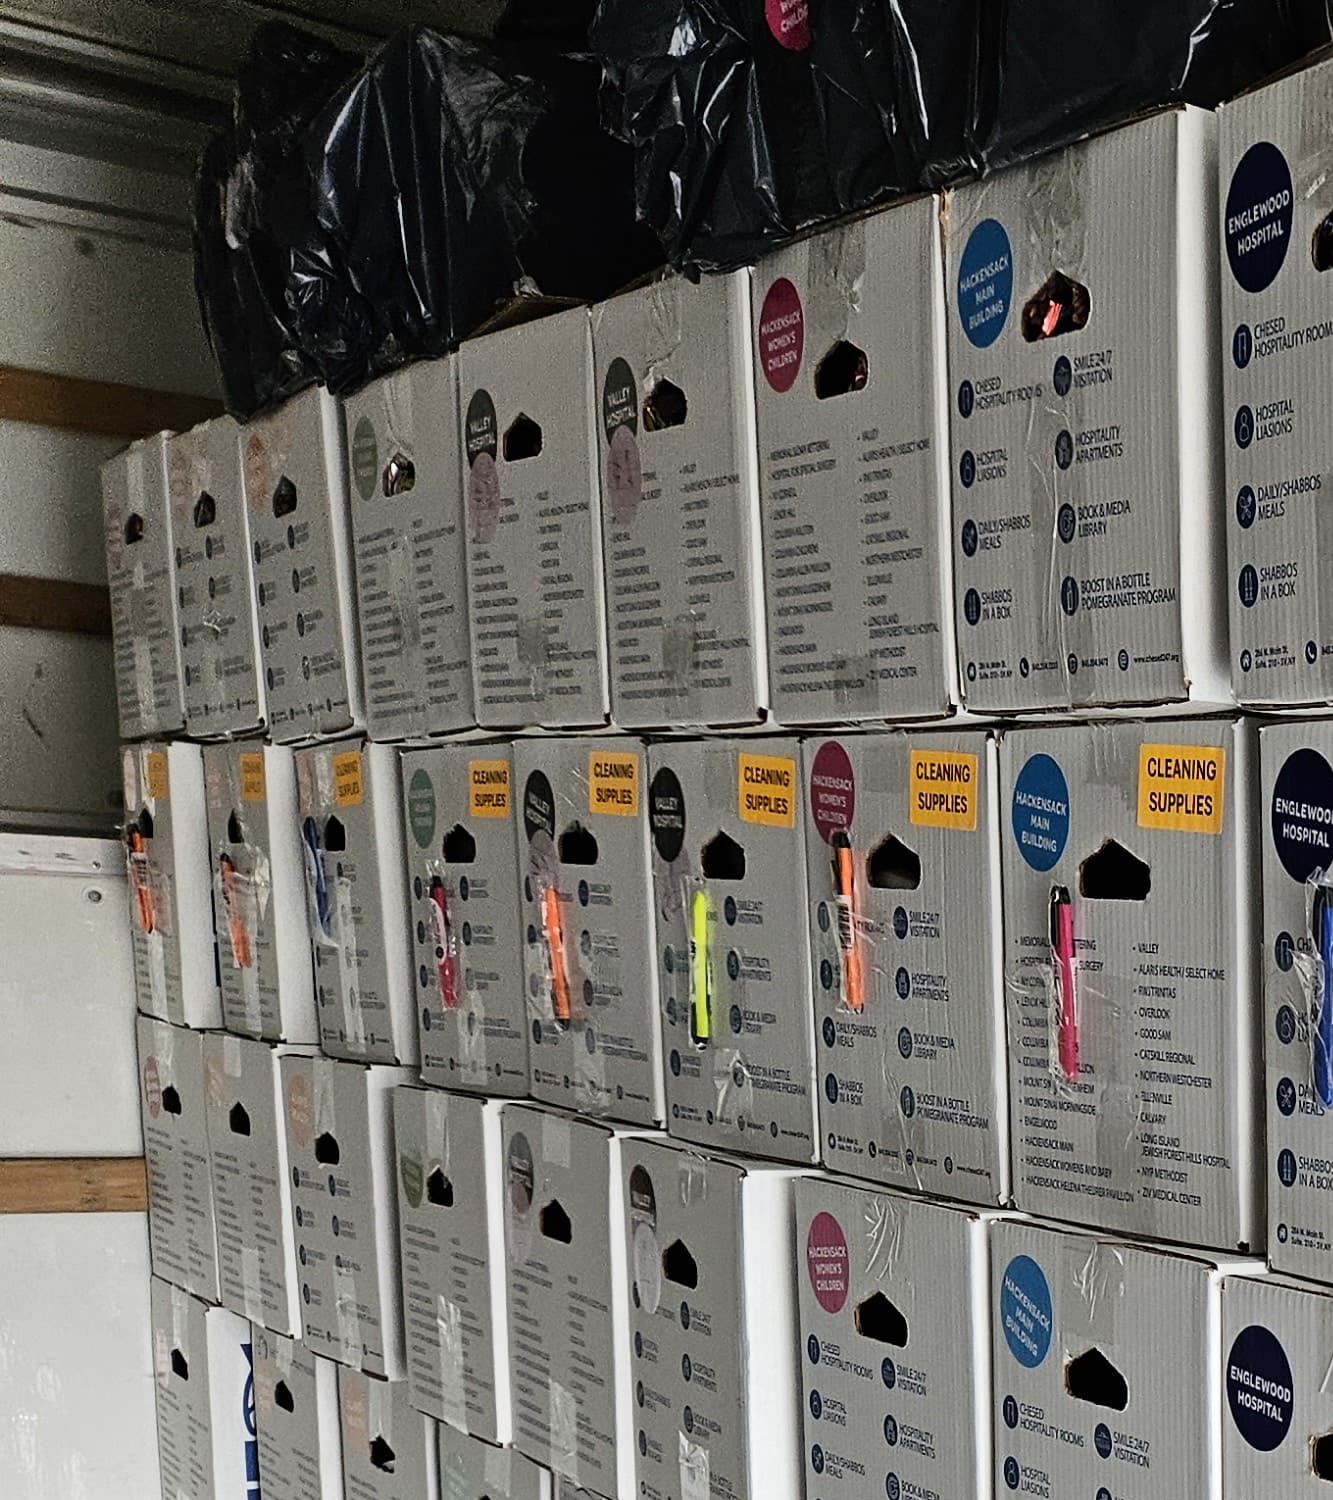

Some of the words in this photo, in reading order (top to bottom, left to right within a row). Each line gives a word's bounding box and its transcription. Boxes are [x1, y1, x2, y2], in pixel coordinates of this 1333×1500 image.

[1229, 189, 1290, 235] ENGLEWOOD
[1238, 223, 1283, 255] HOSPITAL
[473, 770, 507, 785] CLEANING
[594, 763, 633, 779] CLEANING
[744, 767, 789, 787] CLEANING
[475, 794, 506, 807] SUPPLIES
[596, 788, 632, 804] SUPPLIES
[746, 794, 788, 814] SUPPLIES
[1283, 824, 1329, 847] HOSPITAL
[1230, 1365, 1291, 1402] ENGLEWOOD
[1238, 1391, 1282, 1421] HOSPITAL
